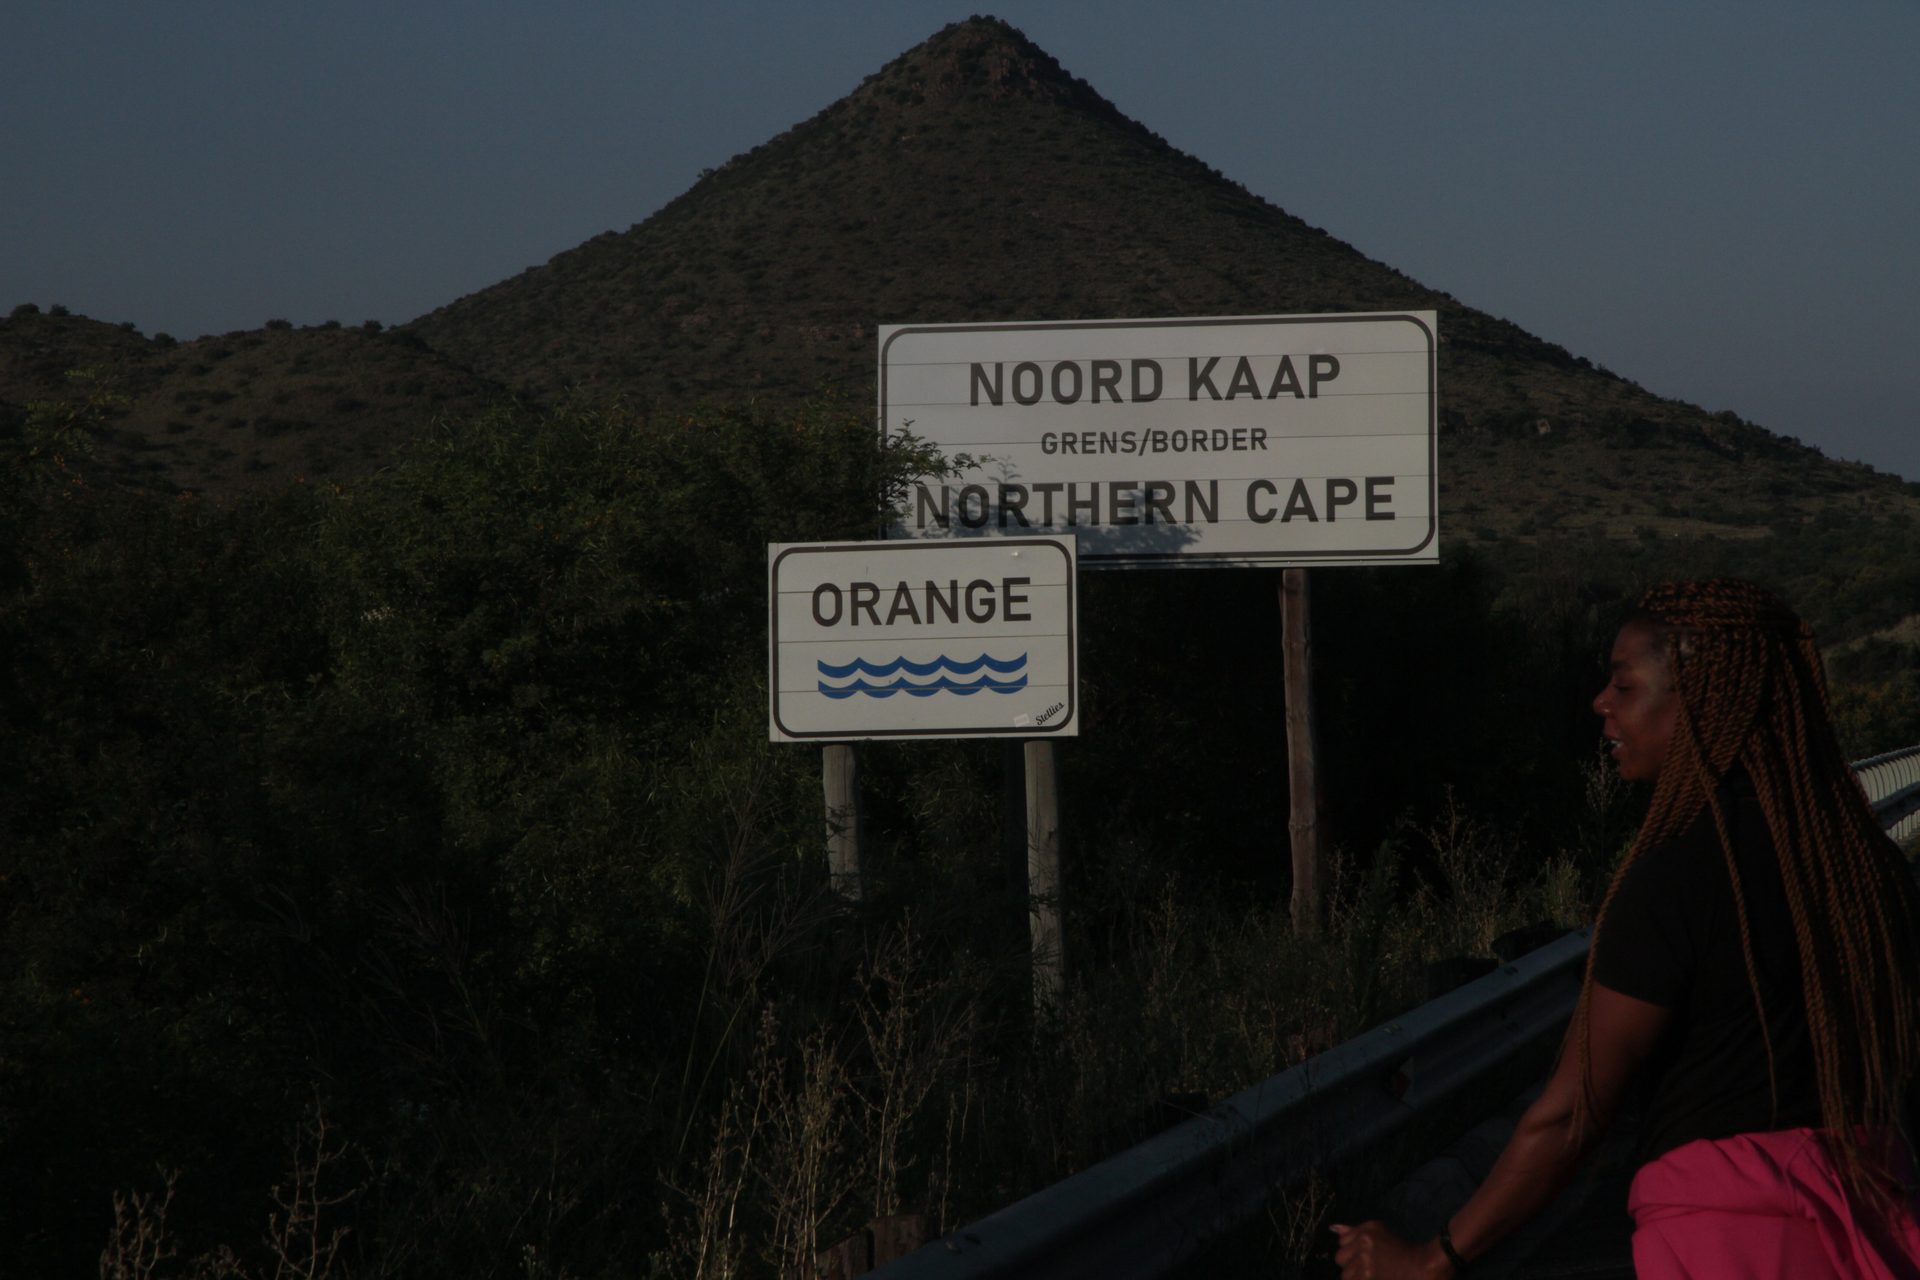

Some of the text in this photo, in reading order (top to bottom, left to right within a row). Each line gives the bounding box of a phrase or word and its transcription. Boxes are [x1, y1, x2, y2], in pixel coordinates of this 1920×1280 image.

[969, 353, 1341, 406] NOORD KAAP
[1041, 427, 1268, 456] GRENS/BORDER
[916, 476, 1396, 530] NORTHERN CAPE
[812, 576, 1032, 627] ORANGE
